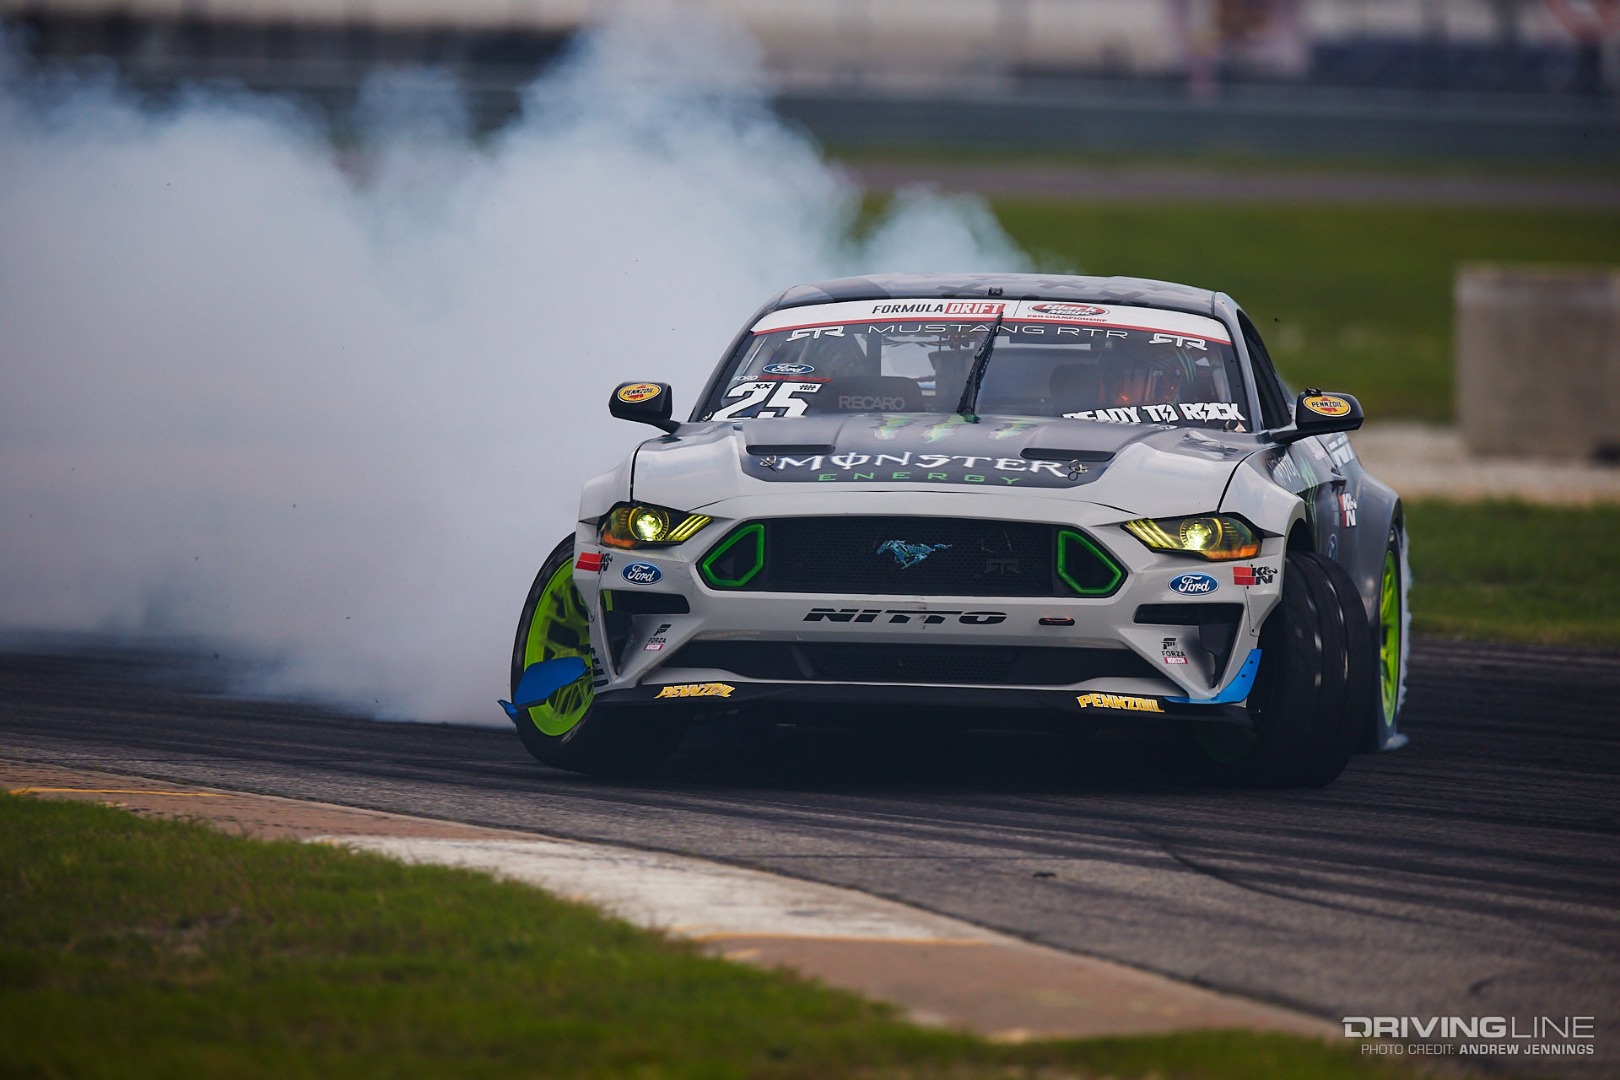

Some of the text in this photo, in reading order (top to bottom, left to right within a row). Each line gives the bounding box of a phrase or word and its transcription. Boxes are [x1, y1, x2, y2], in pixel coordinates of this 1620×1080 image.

[872, 303, 1003, 314] FORMULA DRIFT
[868, 324, 1128, 340] MUSTANG RTR
[710, 381, 823, 421] 25
[838, 395, 905, 410] RECARO
[1311, 400, 1345, 409] PENNZOIL
[1142, 404, 1179, 423] TO
[1179, 402, 1247, 423] ROCK
[776, 450, 1068, 478] MONSTER
[817, 471, 1022, 486] ENERGY
[627, 563, 655, 583] Ford
[1250, 565, 1279, 586] K&N
[1178, 574, 1211, 593] Ford
[802, 607, 1008, 625] NITTO
[653, 682, 736, 699] PENNZOIL
[1076, 692, 1165, 713] PENNZOIL
